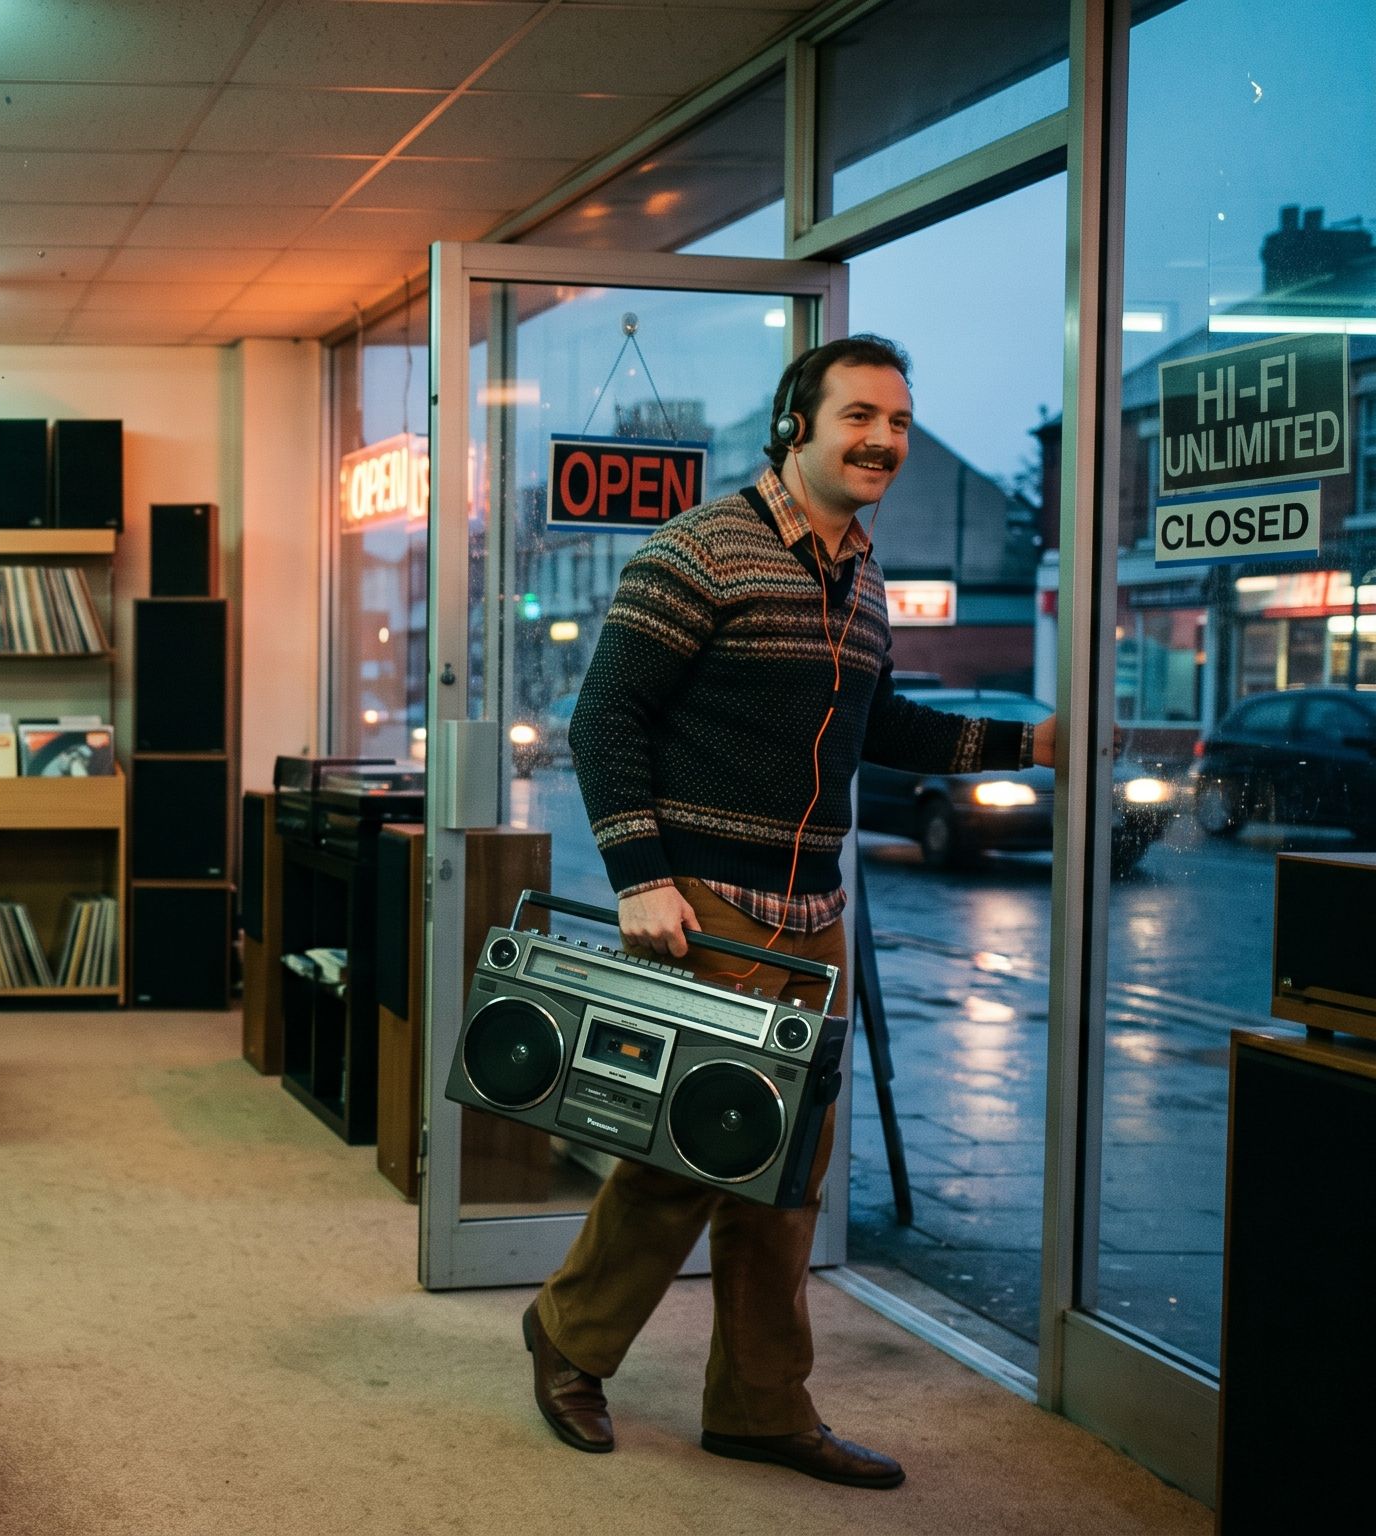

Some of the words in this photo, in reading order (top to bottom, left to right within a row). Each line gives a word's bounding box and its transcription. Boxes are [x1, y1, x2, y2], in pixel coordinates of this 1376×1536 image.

[1197, 352, 1296, 425] HI-FI
[1165, 410, 1340, 478] UNLIMITED
[351, 447, 408, 519] OPEN
[560, 451, 695, 519] OPEN
[1161, 502, 1310, 551] CLOSED
